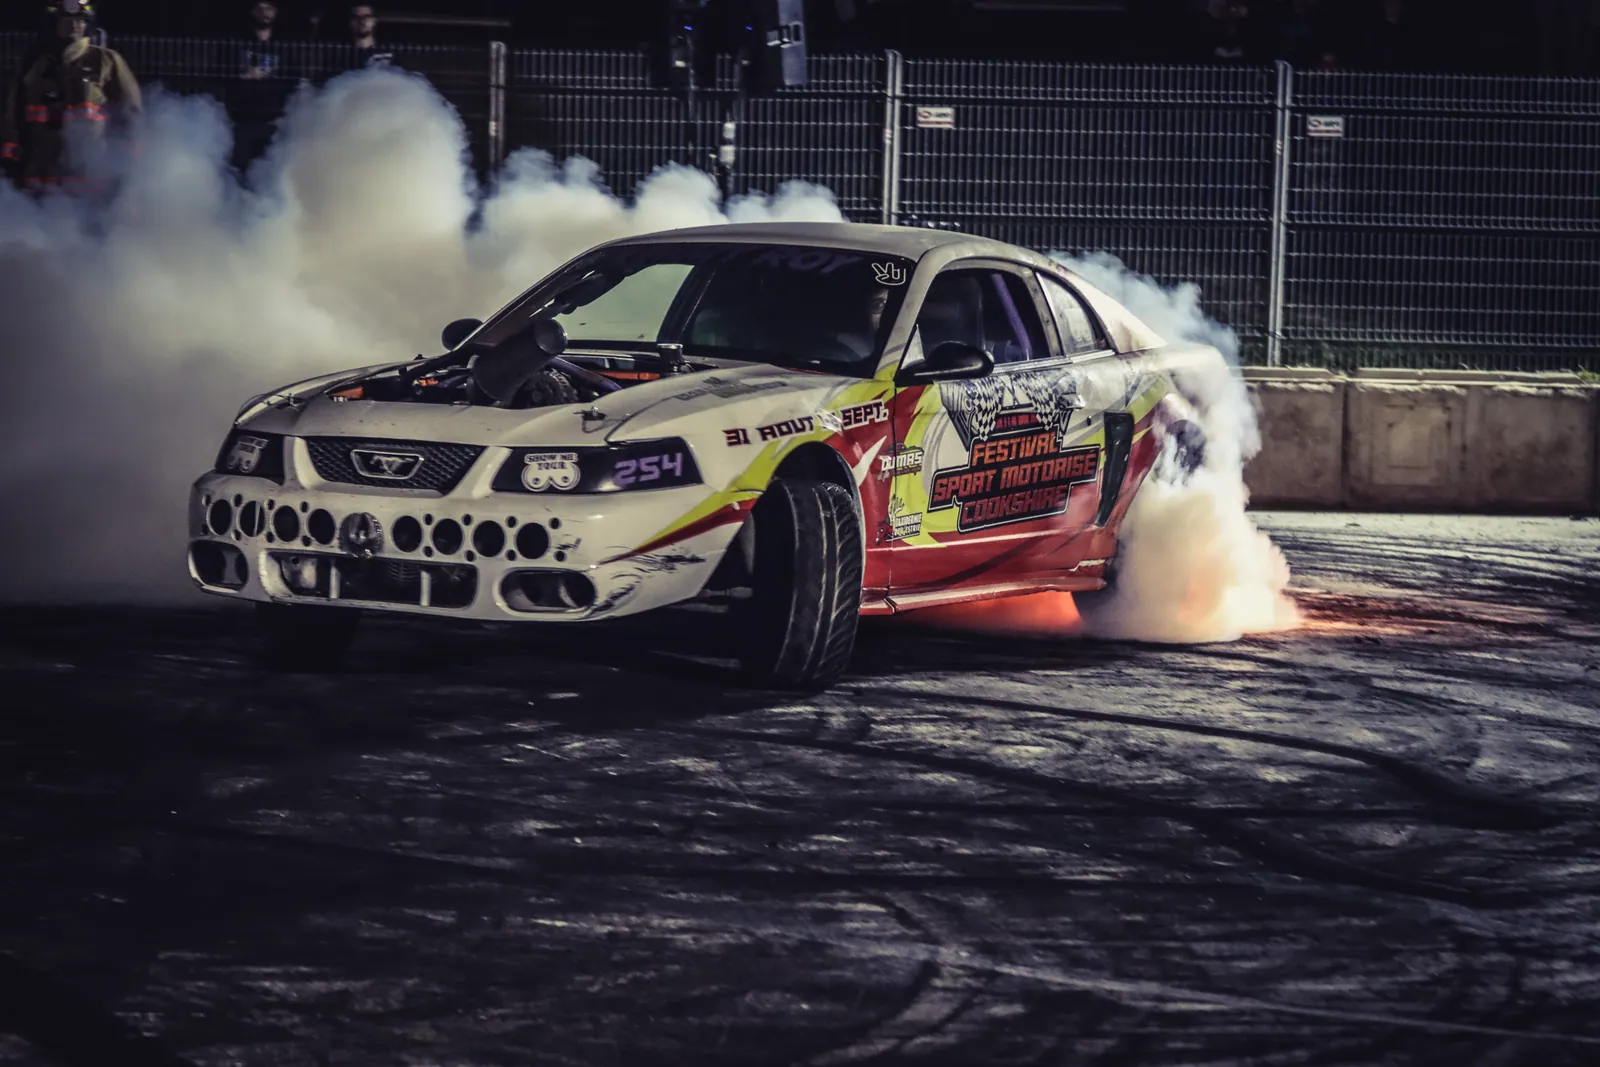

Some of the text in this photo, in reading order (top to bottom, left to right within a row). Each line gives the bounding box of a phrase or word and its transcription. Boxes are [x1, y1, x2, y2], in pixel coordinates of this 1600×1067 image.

[723, 428, 751, 446] 31
[756, 416, 814, 442] AOUT
[840, 401, 887, 427] SEPT.
[528, 453, 574, 463] SHOW ME
[537, 462, 567, 470] YOUR
[879, 451, 923, 472] DUMAS
[972, 432, 1059, 467] FESTIVAL
[613, 452, 683, 486] 254
[933, 469, 997, 502] SPORT
[1000, 450, 1098, 490] MOTORISÉ
[961, 485, 1068, 525] COOKSHIRE
